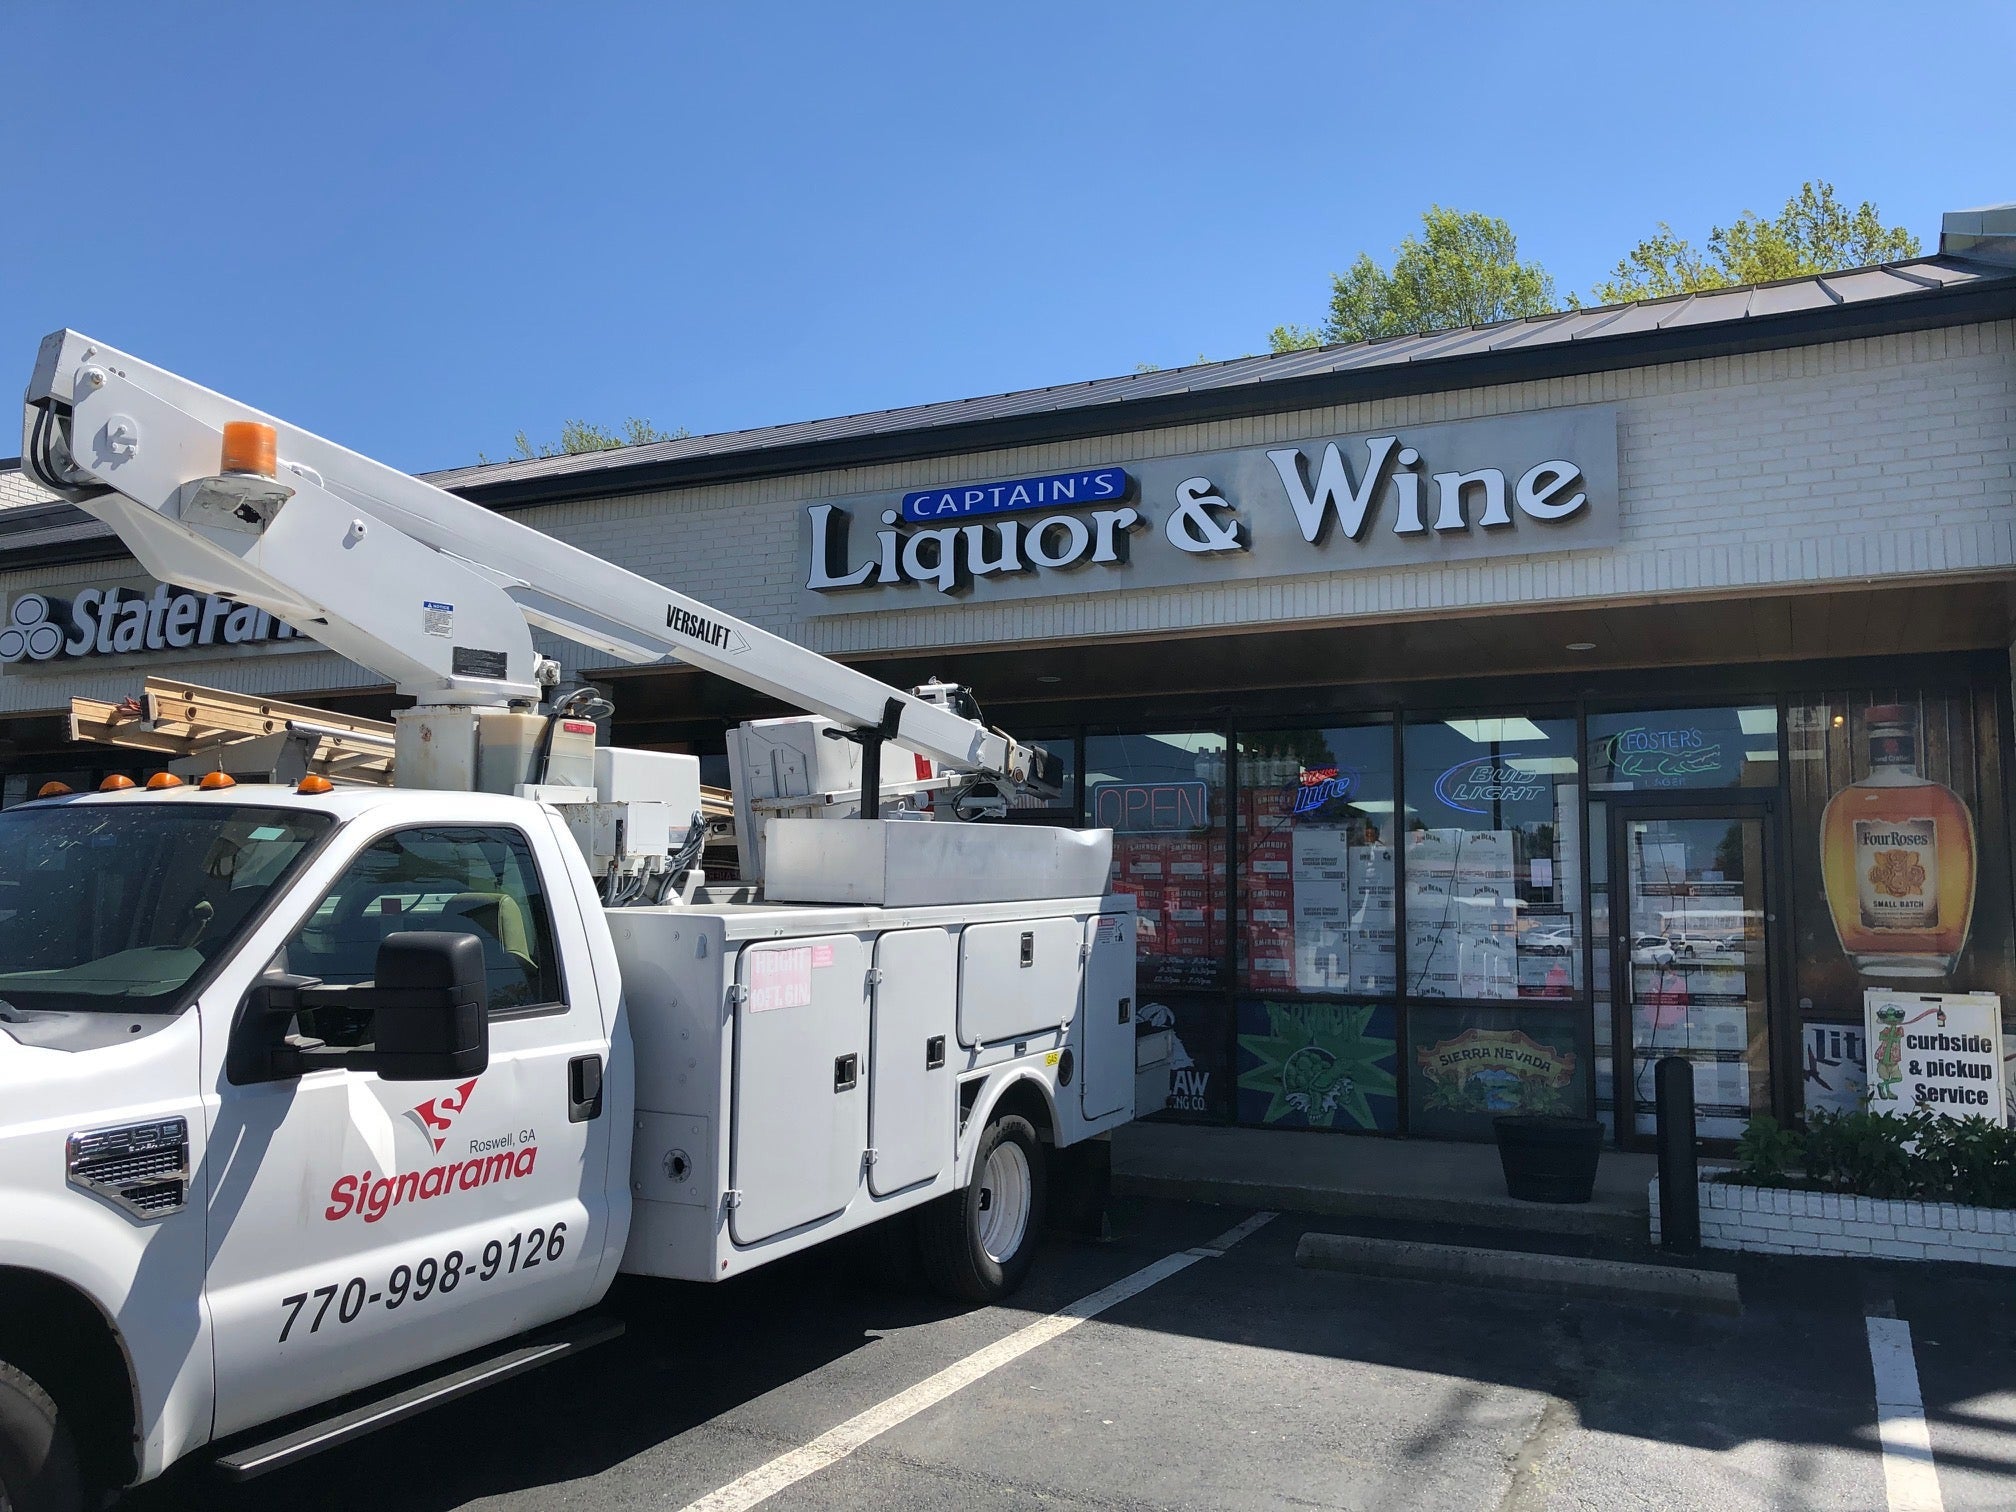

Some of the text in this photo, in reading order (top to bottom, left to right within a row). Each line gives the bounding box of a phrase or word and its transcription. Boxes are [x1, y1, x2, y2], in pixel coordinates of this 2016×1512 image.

[913, 472, 1115, 517] CAPTAIN'S
[805, 435, 1587, 593] Liquor & Wine
[666, 603, 731, 650] VERSALIFT
[1627, 727, 1702, 751] FOSTER'S
[1469, 766, 1537, 784] BUD
[1293, 778, 1350, 813] Lite
[1452, 786, 1546, 801] LIGHT
[1099, 787, 1202, 828] OPEN
[1873, 900, 1898, 908] SMALL
[1906, 1033, 1992, 1054] curbside
[1439, 1046, 1552, 1073] SIERRA NEVADA
[1909, 1059, 1992, 1081] & pickup
[1915, 1083, 1989, 1105] Service
[469, 1128, 536, 1154] Roswell, GA
[325, 1146, 538, 1223] Signarama
[278, 1221, 567, 1343] 770-998-9126
